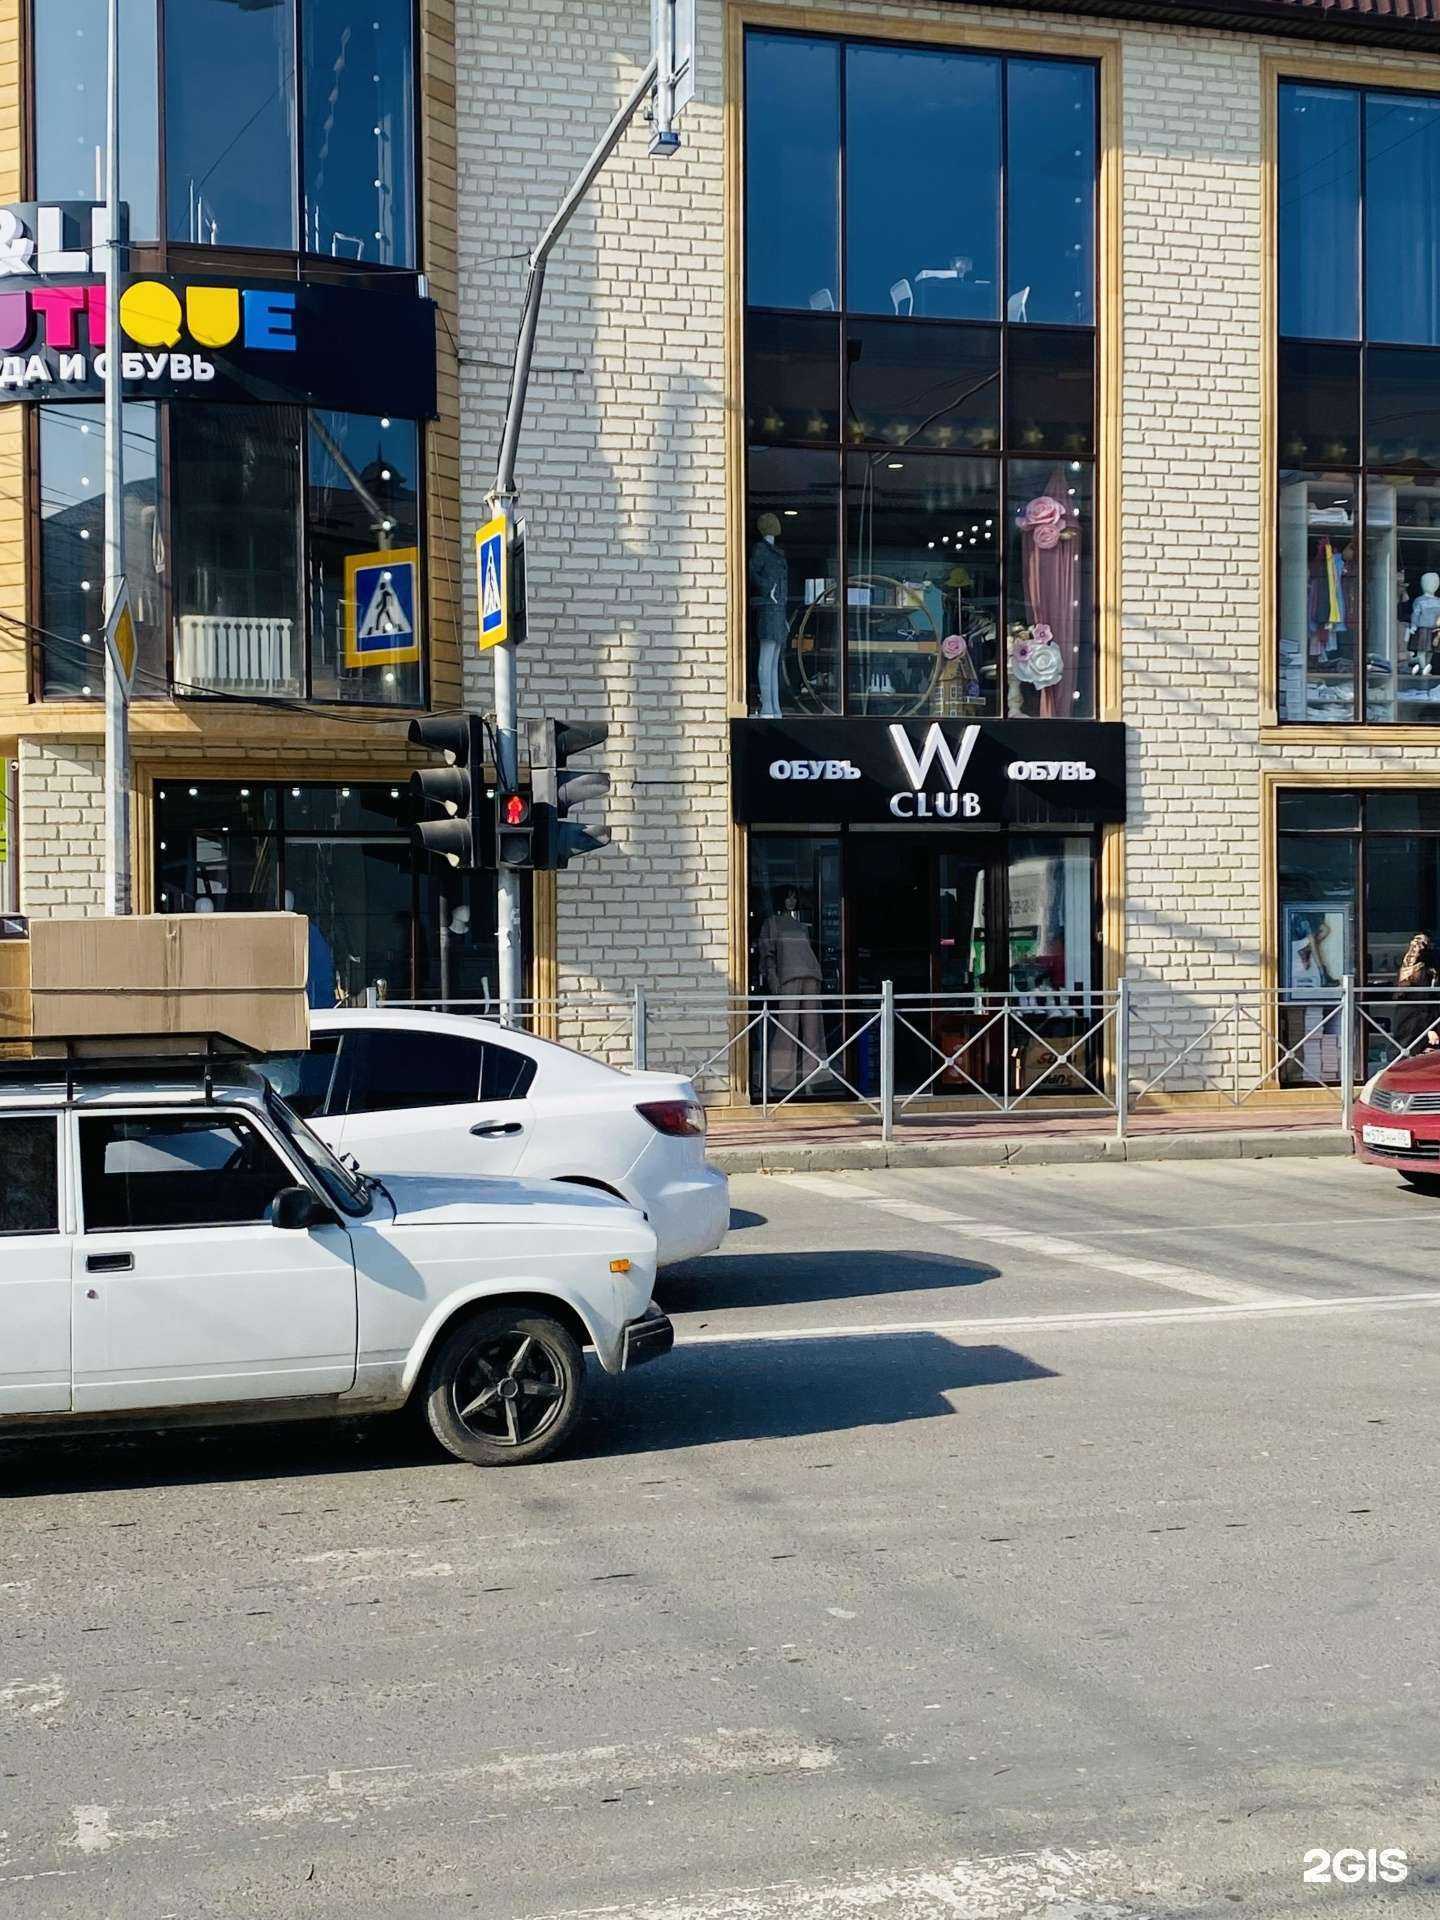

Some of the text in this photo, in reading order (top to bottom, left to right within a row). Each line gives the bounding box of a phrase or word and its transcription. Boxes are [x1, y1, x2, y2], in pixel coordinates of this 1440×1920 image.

[0, 353, 53, 387] ДА
[59, 353, 87, 381] И
[889, 722, 982, 790] W
[769, 759, 862, 780] ОБУВЬ
[1008, 760, 1096, 781] ОБУВЬ
[889, 792, 982, 818] CLUB
